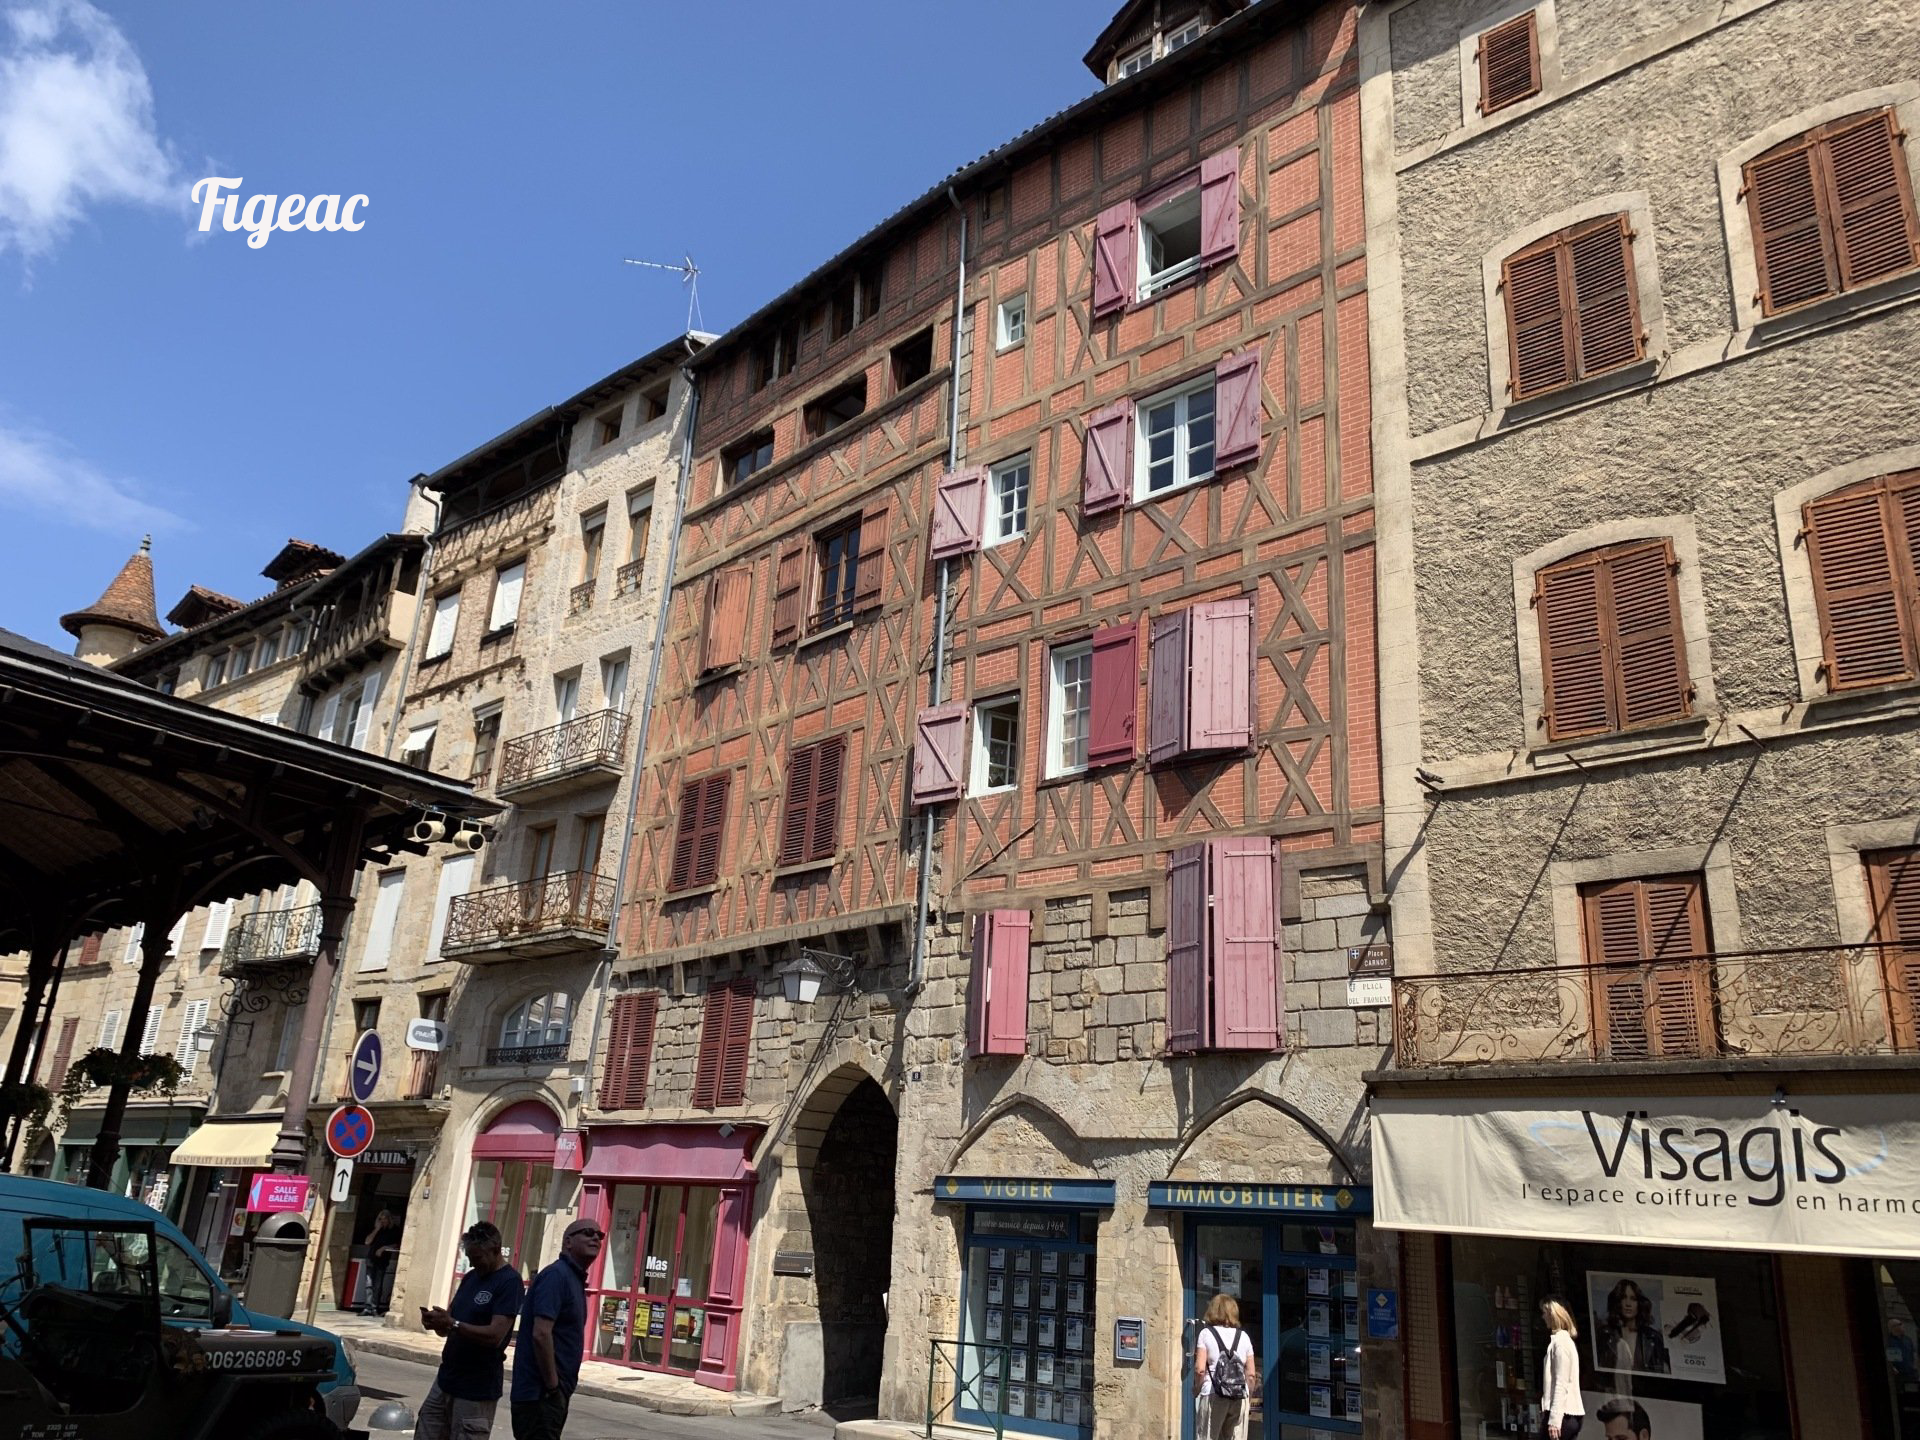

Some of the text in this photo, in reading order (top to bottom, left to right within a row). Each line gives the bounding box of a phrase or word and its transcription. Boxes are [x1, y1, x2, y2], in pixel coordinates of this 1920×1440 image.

[1364, 958, 1388, 967] CARNOT
[558, 1137, 577, 1151] Mas
[1581, 1110, 1847, 1207] Visagis
[273, 1186, 297, 1194] SALLE
[982, 1180, 1053, 1198] VIGIER
[1167, 1185, 1324, 1207] IMMOBILIER
[1636, 1189, 1737, 1208] coiffure
[1796, 1196, 1826, 1210] en
[646, 1256, 668, 1271] Mas
